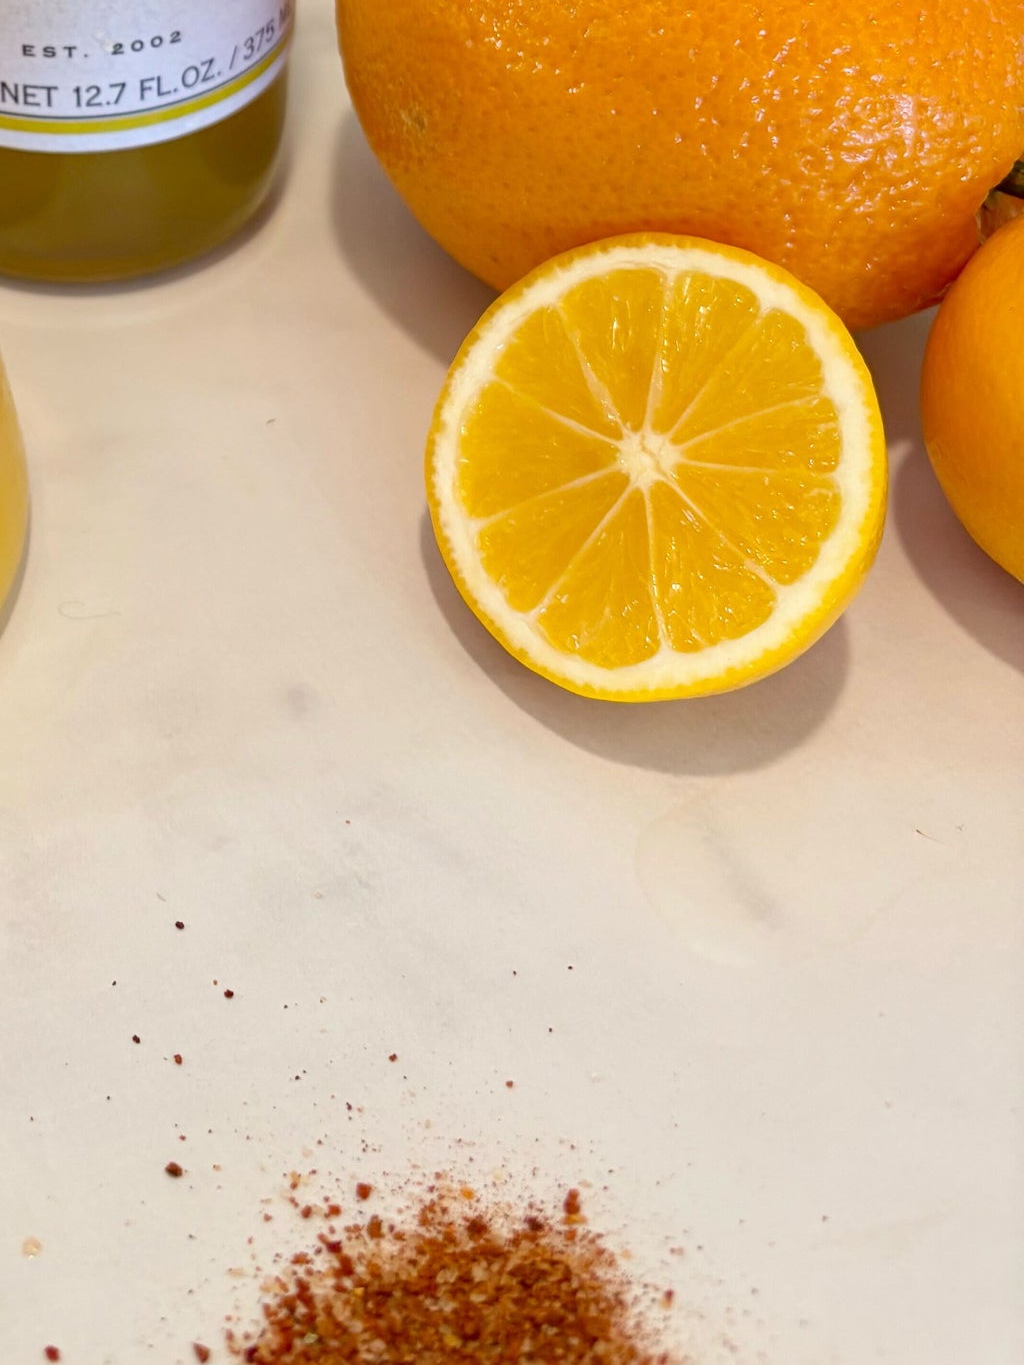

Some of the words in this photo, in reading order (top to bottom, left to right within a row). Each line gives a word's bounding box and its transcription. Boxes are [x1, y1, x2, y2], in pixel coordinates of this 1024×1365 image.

[22, 44, 88, 58] EST.
[111, 31, 181, 55] 2002
[0, 81, 58, 107] NET
[73, 82, 127, 108] 12.7
